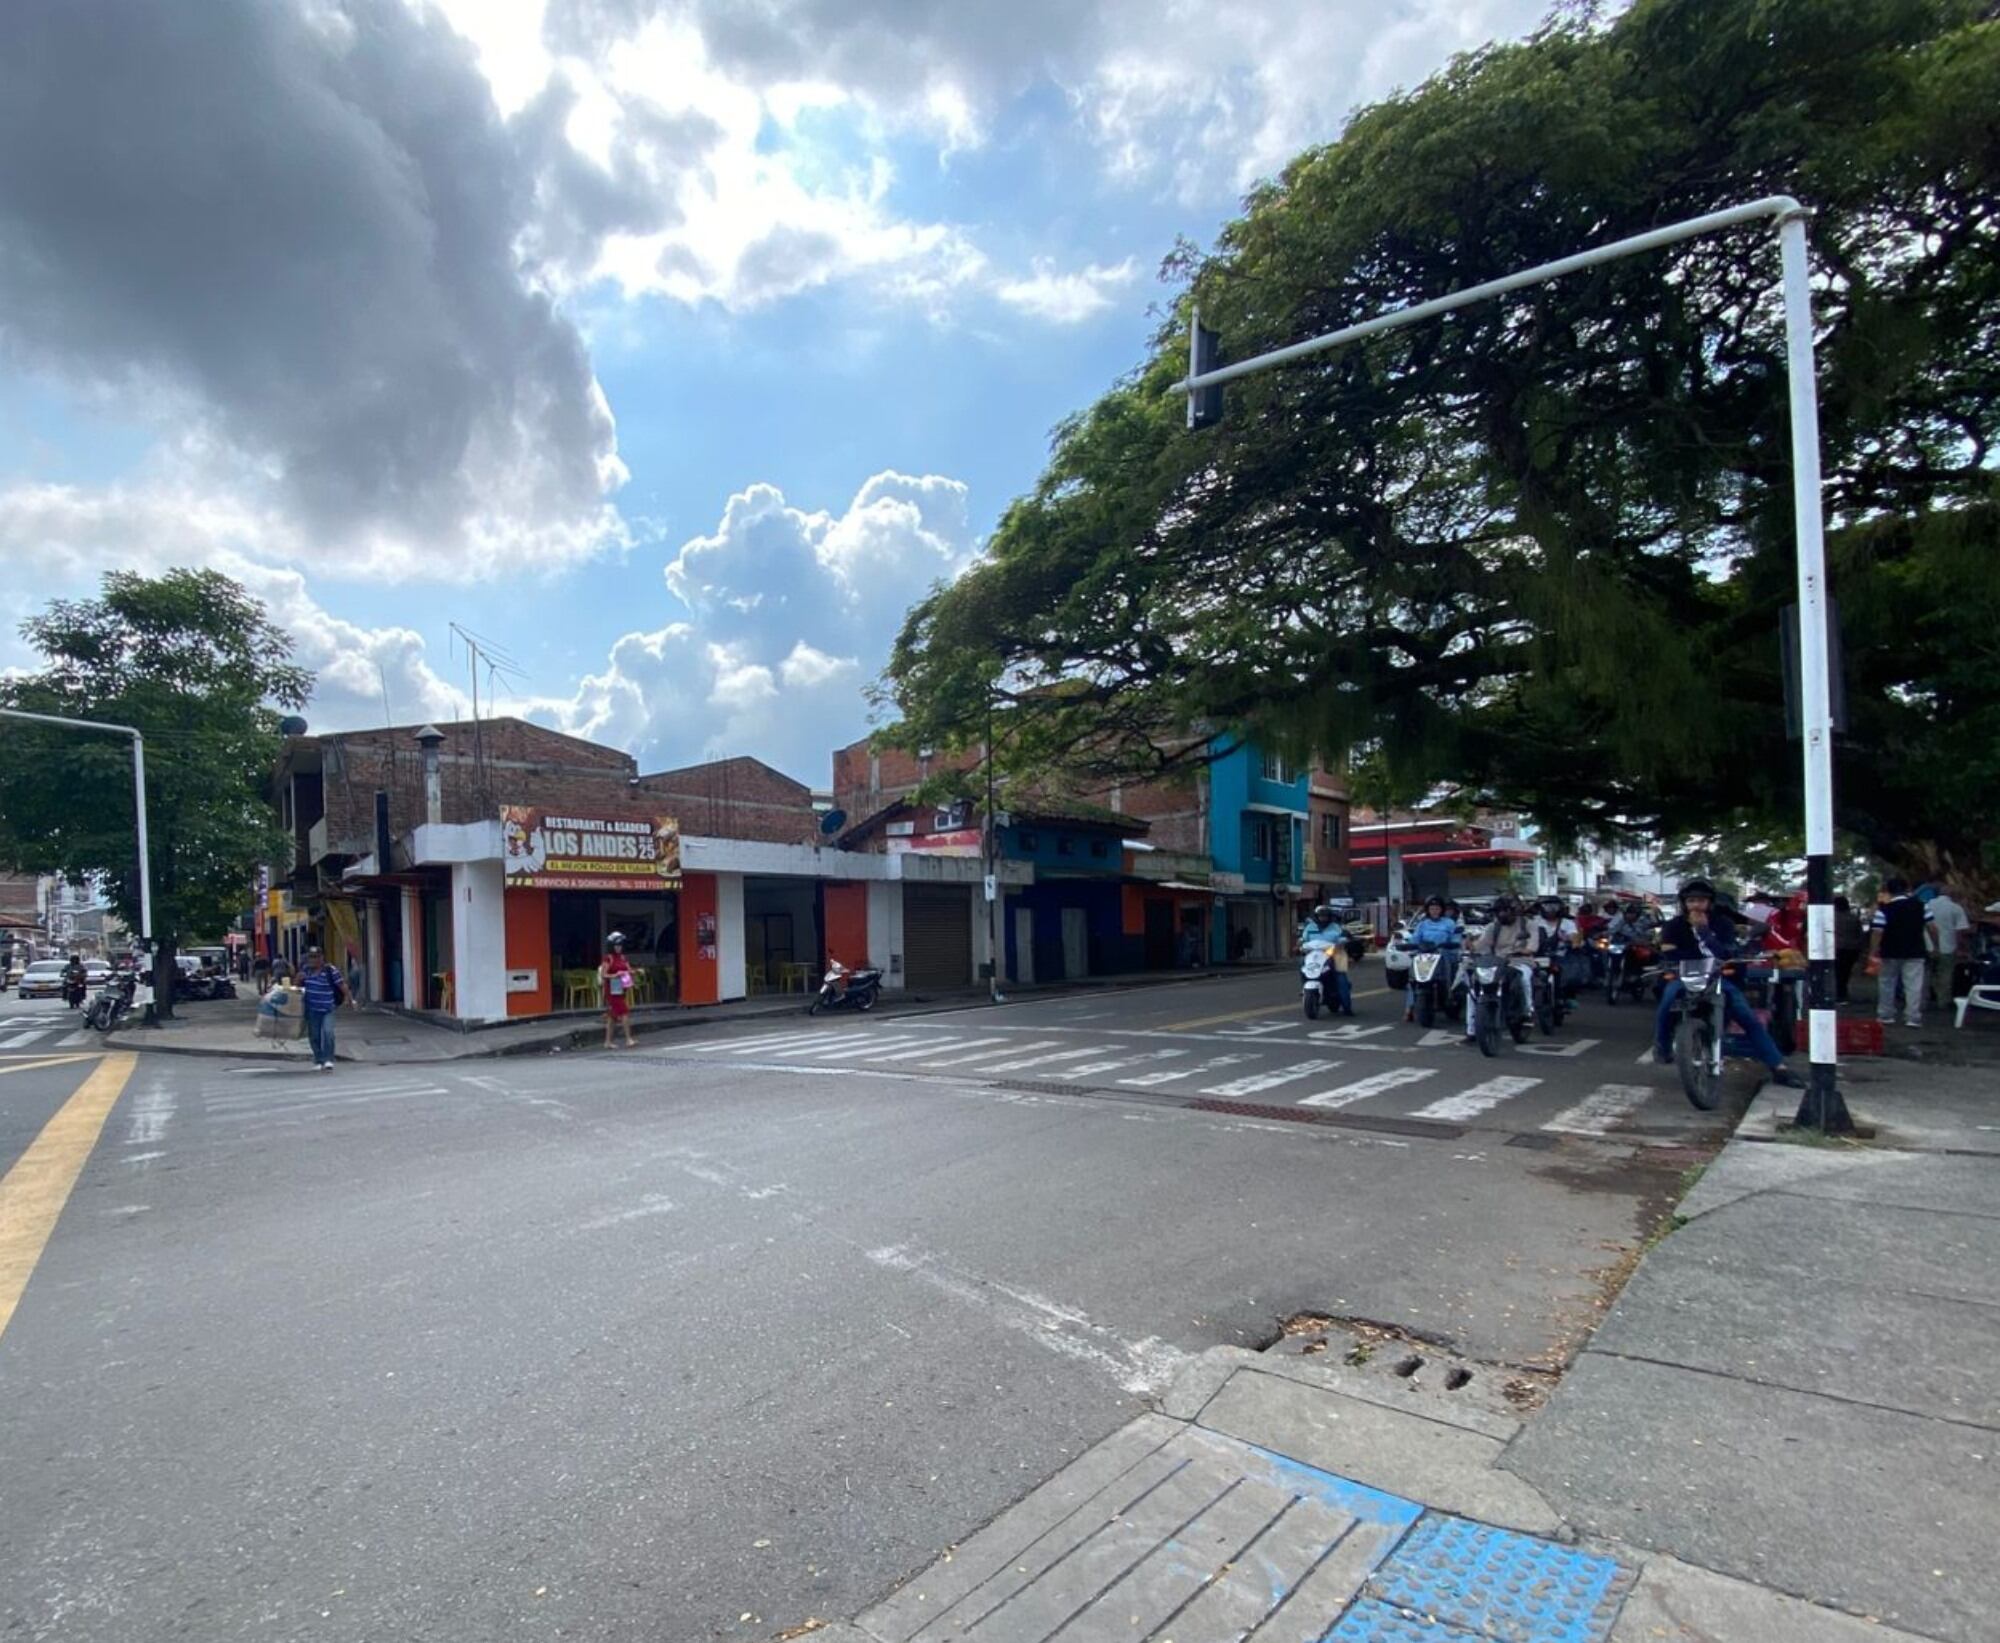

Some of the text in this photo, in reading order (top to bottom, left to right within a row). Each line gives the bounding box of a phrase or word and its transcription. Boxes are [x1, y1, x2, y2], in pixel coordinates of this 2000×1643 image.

[545, 816, 606, 832] RESTAURANTE
[544, 831, 638, 859] LOS ANDES
[639, 844, 655, 860] 25
[561, 861, 587, 870] MEJOR
[590, 862, 614, 871] POLLO
[534, 878, 570, 888] SERVICIO
[577, 879, 616, 889] DOMICILIO
